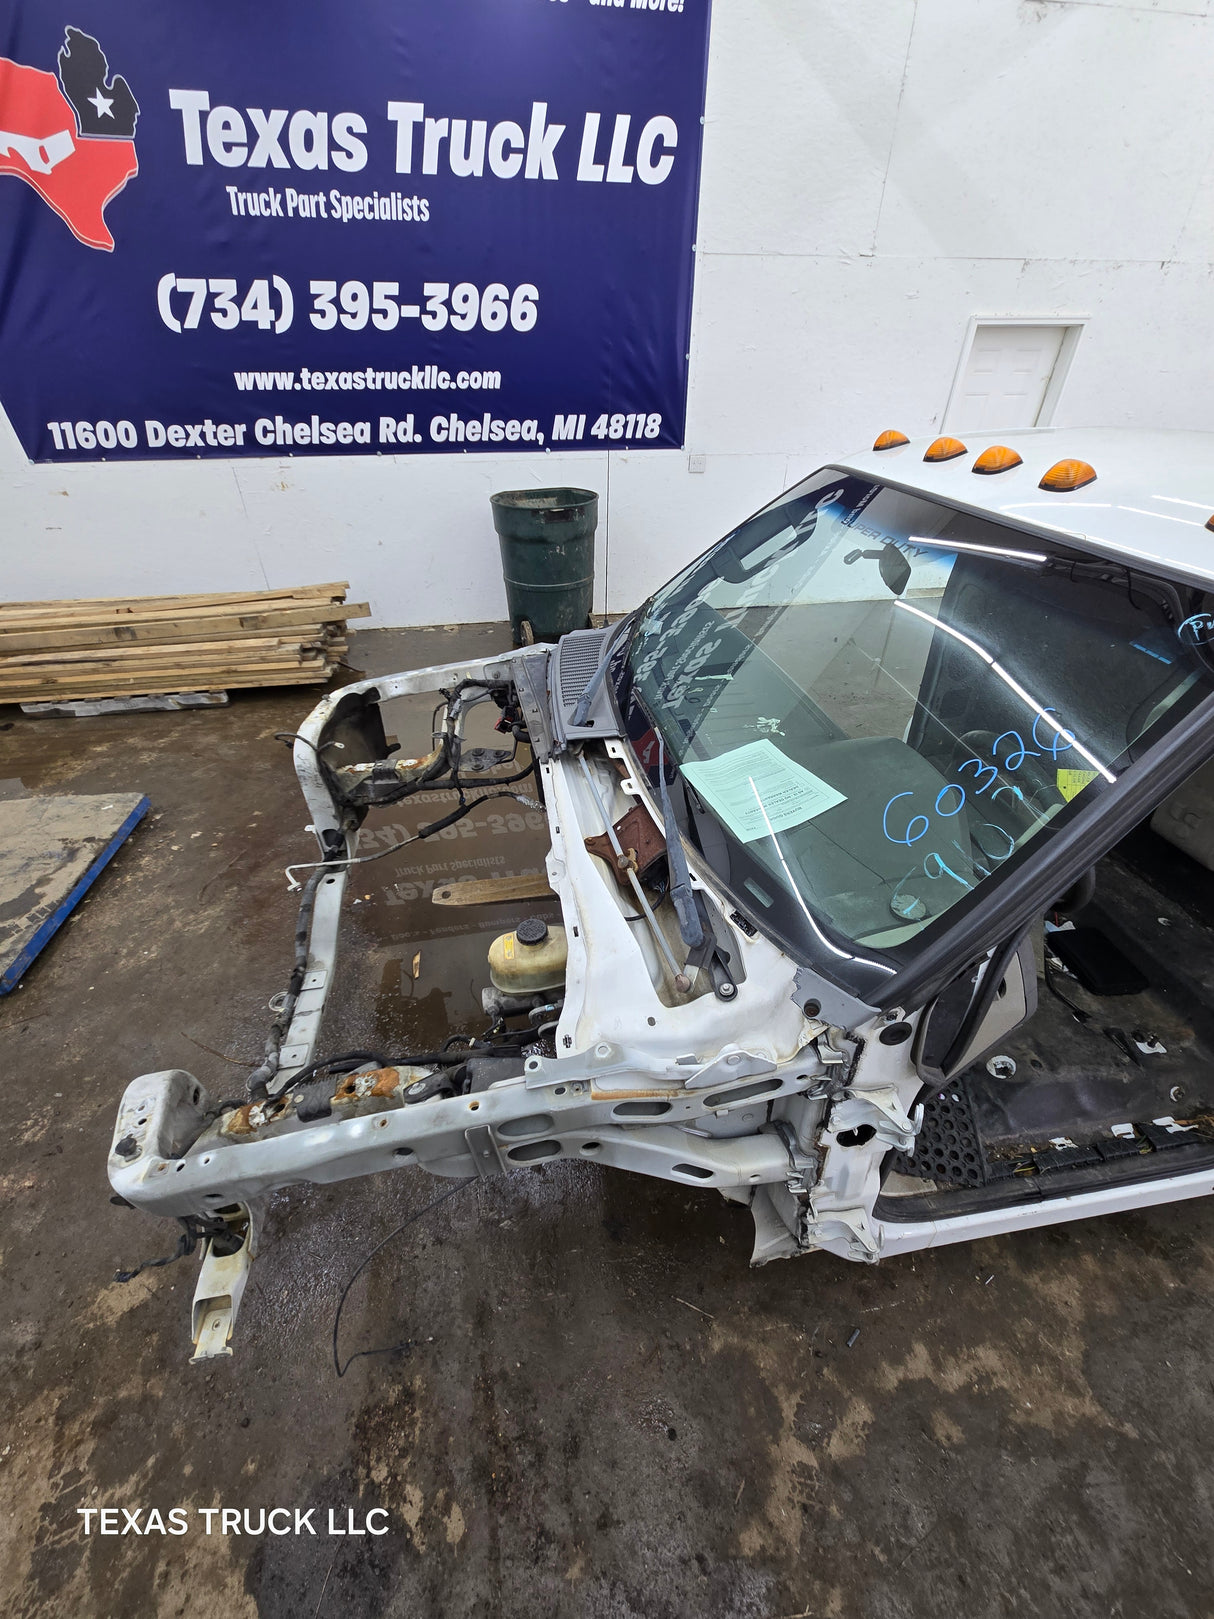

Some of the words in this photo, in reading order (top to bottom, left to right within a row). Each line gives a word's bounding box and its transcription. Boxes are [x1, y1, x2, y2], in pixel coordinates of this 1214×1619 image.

[168, 88, 368, 173] Texas
[387, 100, 567, 181] Truck
[576, 112, 679, 185] LLC
[225, 185, 284, 217] Truck
[285, 187, 328, 219] Part
[329, 189, 430, 223] Specialists
[157, 272, 294, 335] (734)
[309, 280, 540, 332] 395-3966
[233, 365, 502, 391] www.texastruckllc.com
[46, 420, 138, 450] 11600
[146, 419, 247, 448] Dexter
[254, 415, 371, 446] Chelsea
[379, 413, 423, 443] Rd.
[429, 412, 545, 446] Chelsea,
[551, 414, 587, 441] MI
[591, 413, 662, 440] 48118
[841, 519, 882, 541] SUPER
[880, 535, 929, 558] DUTY
[882, 706, 1076, 848] 60326
